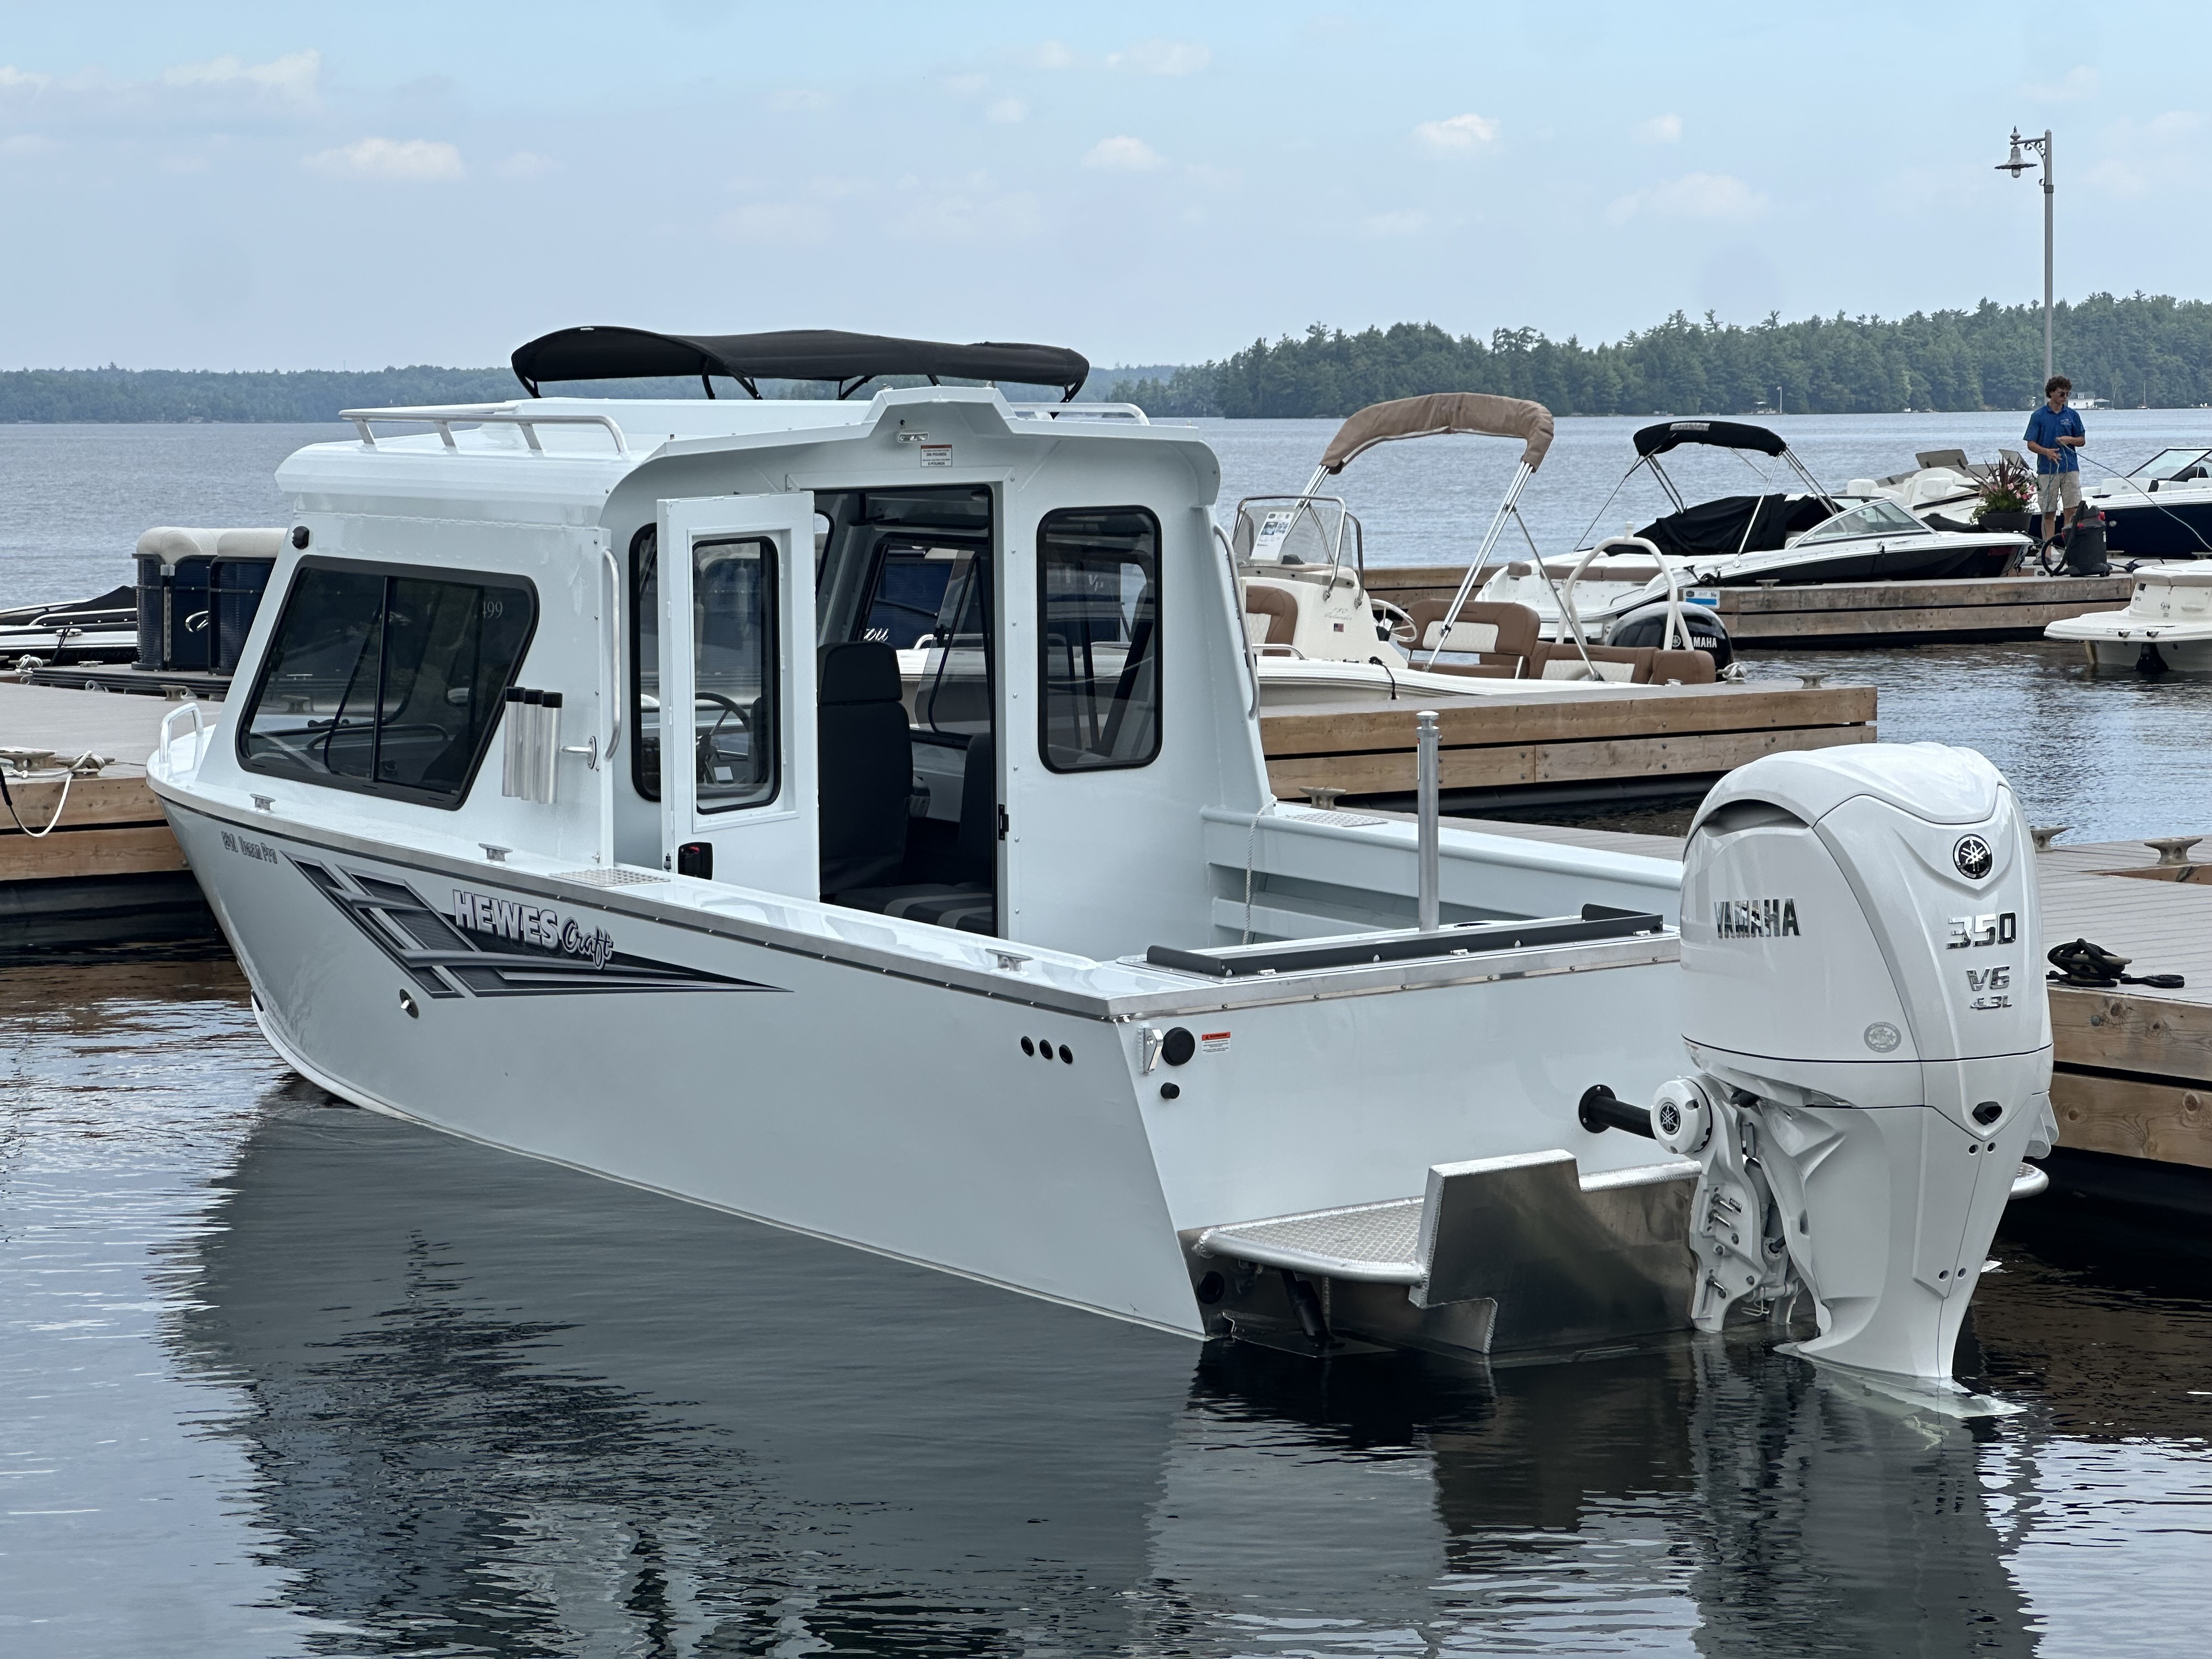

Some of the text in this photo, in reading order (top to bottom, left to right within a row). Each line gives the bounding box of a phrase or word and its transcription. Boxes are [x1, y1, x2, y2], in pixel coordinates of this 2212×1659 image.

[1690, 636, 1718, 648] MAHA
[238, 836, 263, 860] Ocean
[261, 842, 278, 865] Pro
[452, 889, 614, 970] HEWES Craft
[1714, 898, 1801, 939] YAMAHA
[1946, 911, 2017, 950] 350
[1966, 964, 2011, 991] V6
